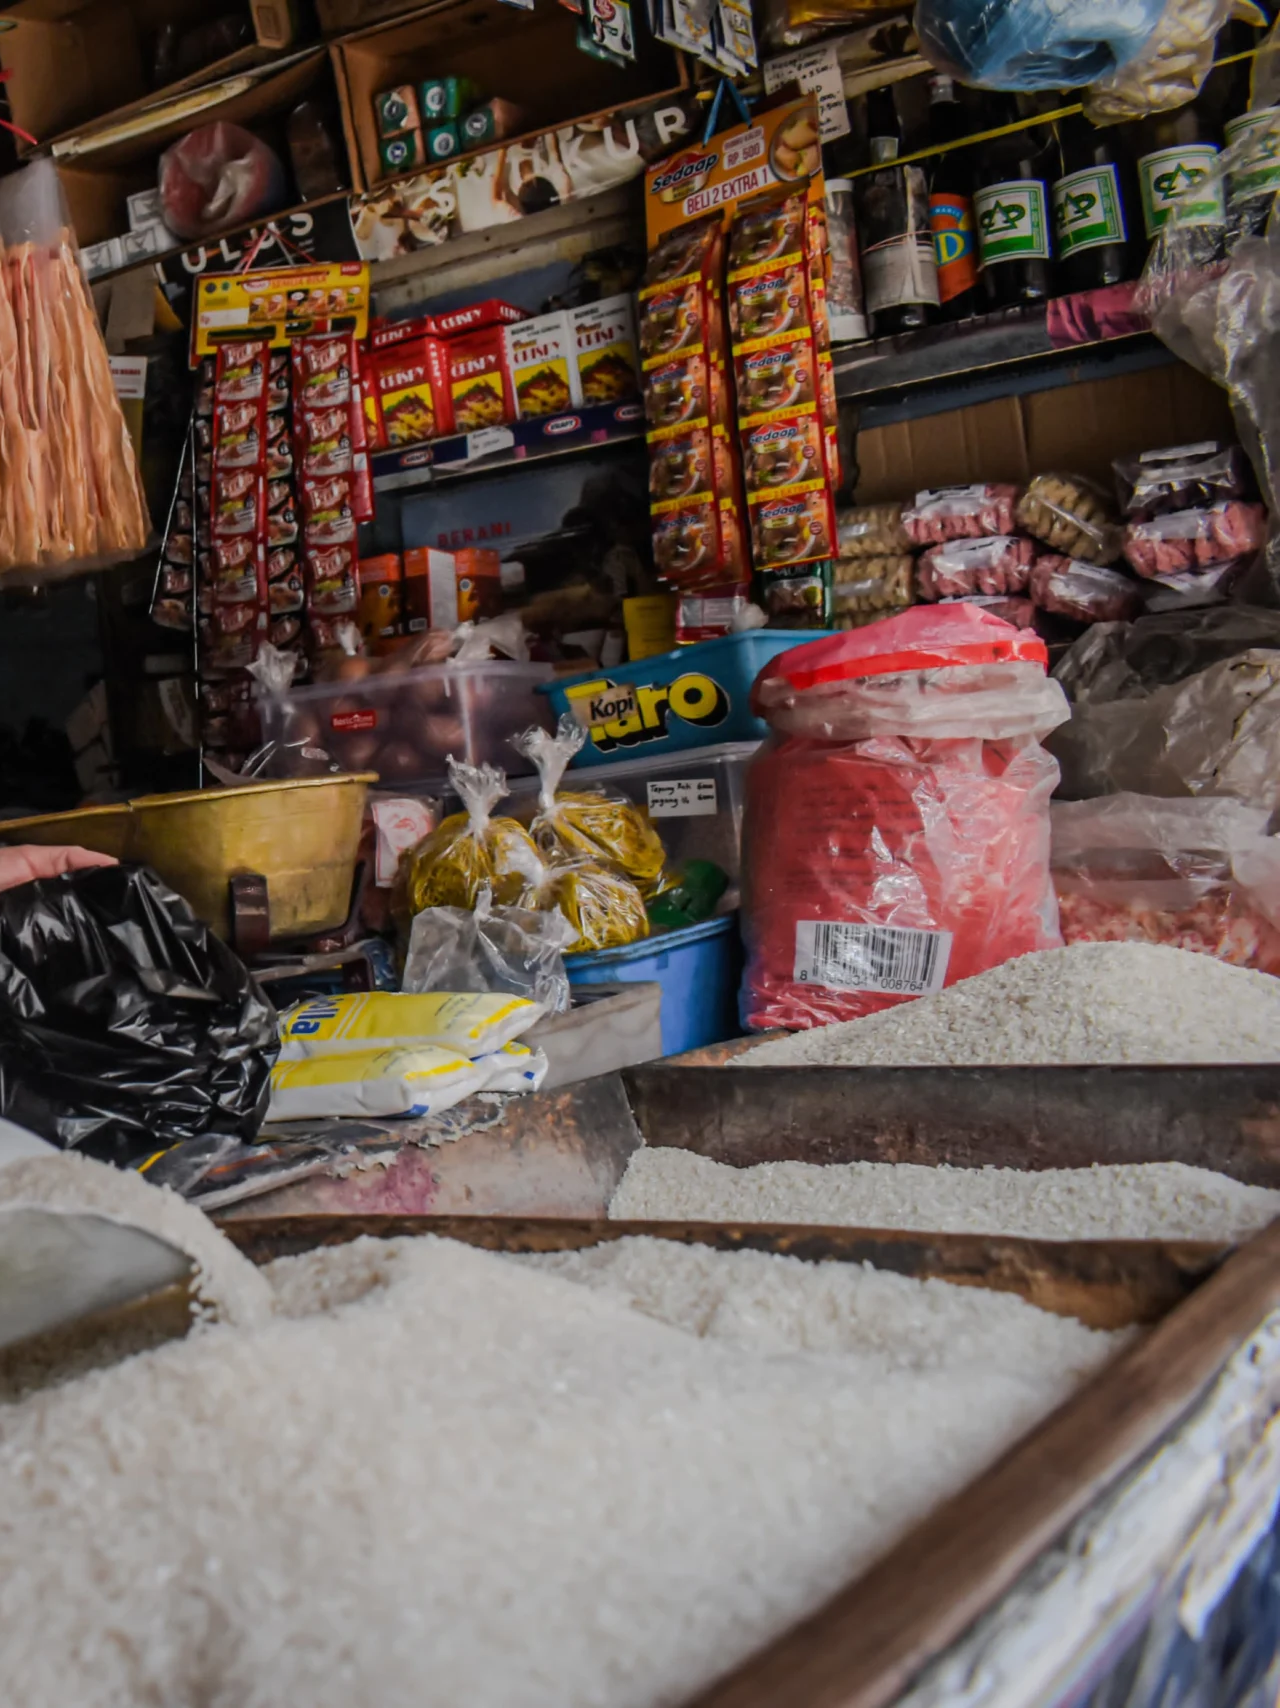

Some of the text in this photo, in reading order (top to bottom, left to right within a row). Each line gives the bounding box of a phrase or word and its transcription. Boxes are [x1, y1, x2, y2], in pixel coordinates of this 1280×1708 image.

[651, 153, 718, 194] Sedaap
[686, 193, 711, 215] BELI
[712, 186, 720, 204] 2
[721, 171, 759, 201] EXTRA
[736, 277, 784, 296] Sedaap
[440, 309, 483, 330] CRISPY
[374, 326, 413, 347] CRISPY
[513, 340, 561, 364] CRISPY
[744, 351, 791, 369] Sedaap
[451, 354, 498, 378] CRISPY
[379, 366, 426, 391] CRISPY
[750, 427, 798, 444] Sedaap
[759, 502, 805, 519] Sedaap
[437, 522, 512, 547] BERANI
[589, 692, 635, 721] Kopi
[799, 969, 808, 981] 8
[880, 977, 925, 992] 008764
